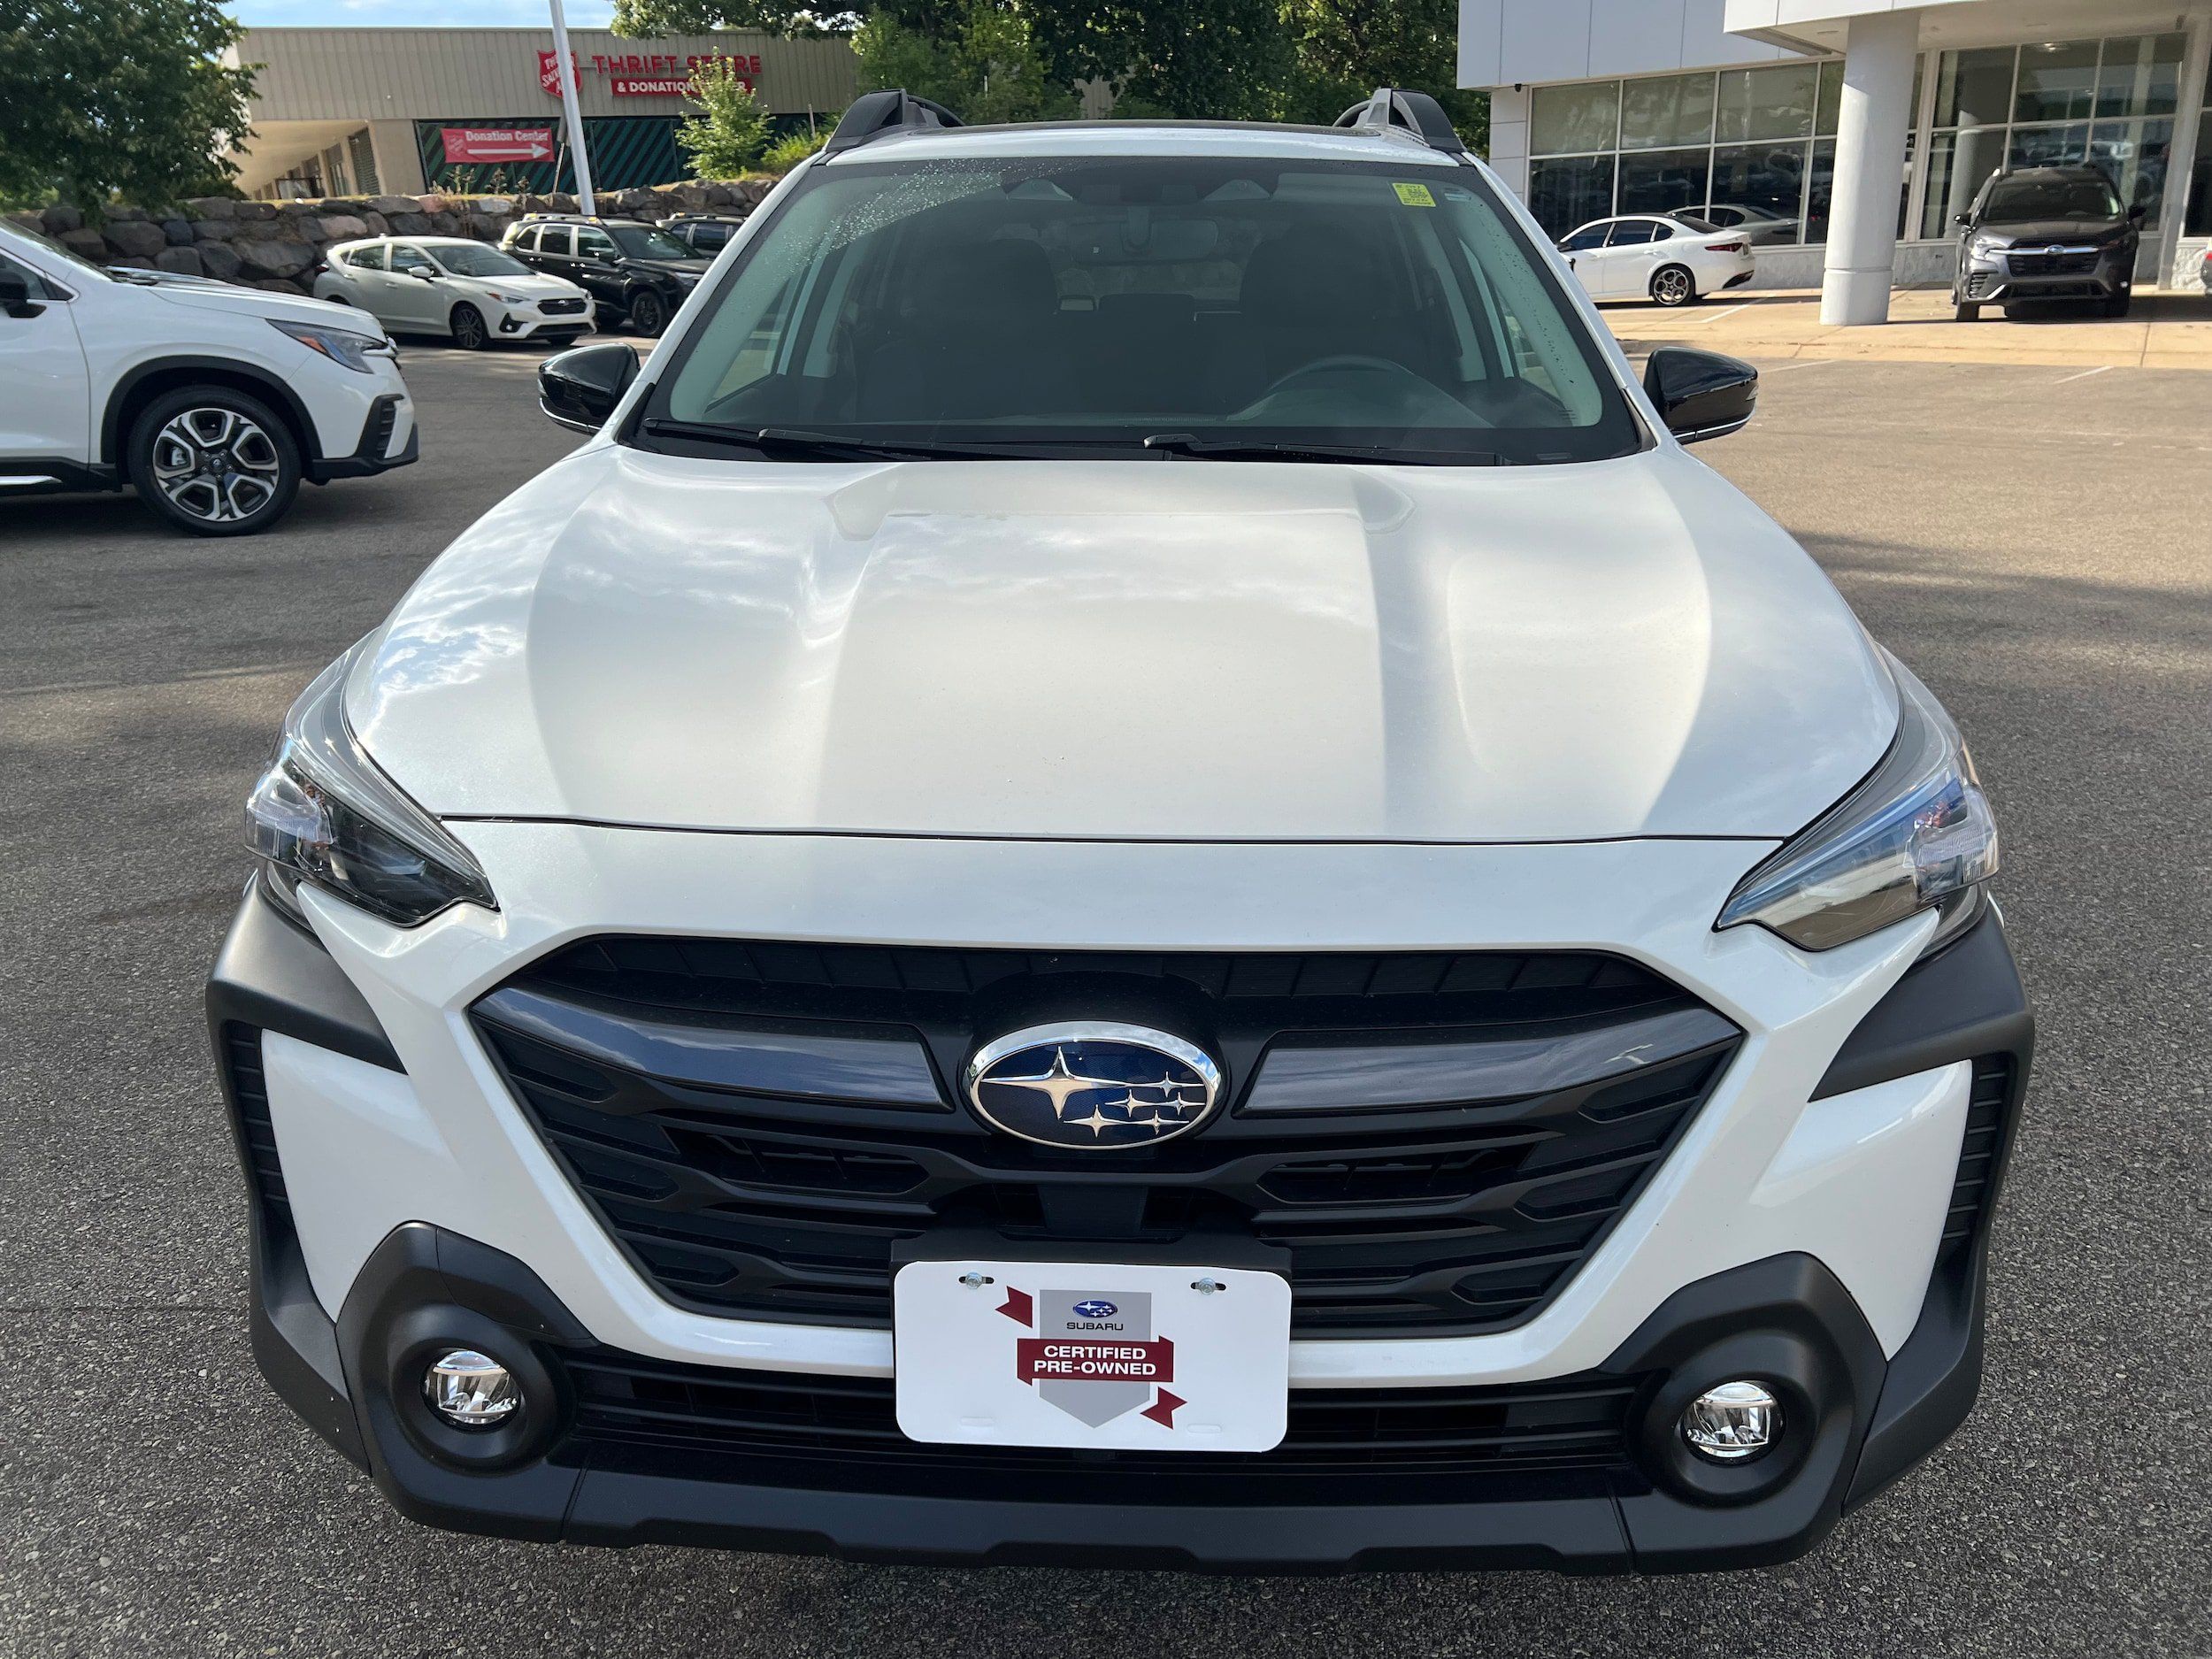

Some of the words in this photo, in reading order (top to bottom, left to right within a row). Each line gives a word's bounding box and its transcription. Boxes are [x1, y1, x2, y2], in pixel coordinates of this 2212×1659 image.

[592, 55, 678, 74] THRIFT
[617, 81, 626, 93] &
[629, 81, 696, 93] DONATION
[465, 130, 513, 142] Donation
[514, 130, 549, 142] Center
[1066, 1322, 1124, 1331] SUBARU
[1043, 1345, 1147, 1360] CERTIFIED
[1033, 1360, 1156, 1376] PRE-OWNED
